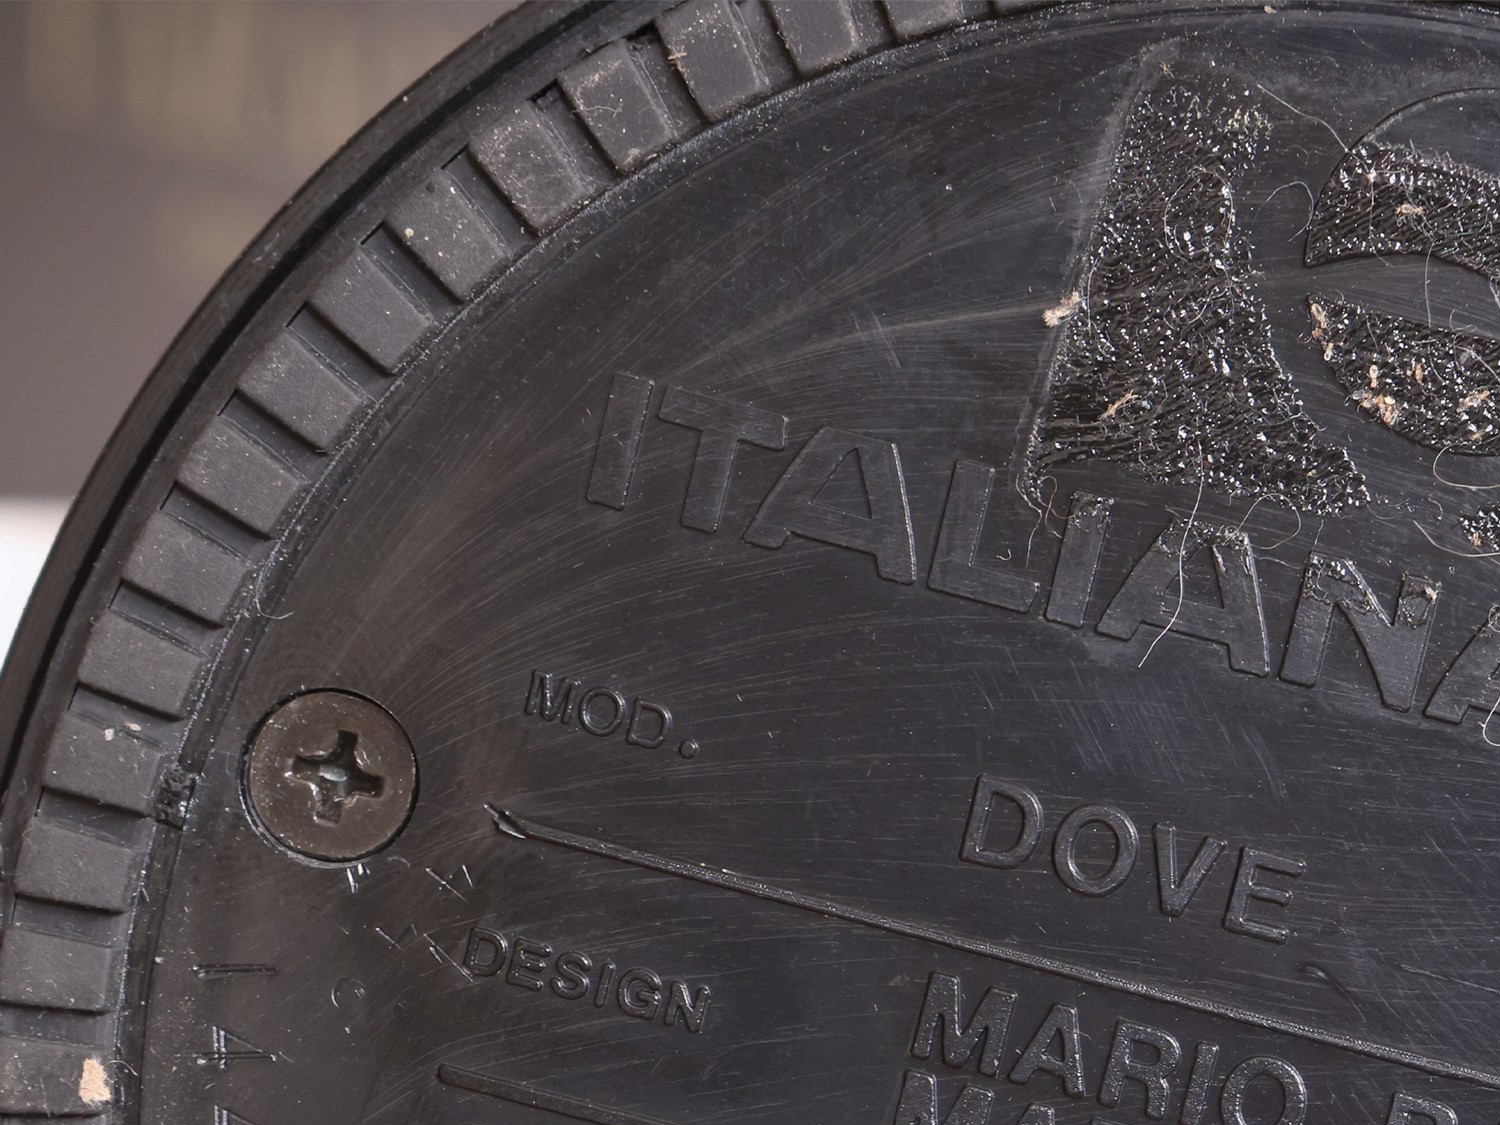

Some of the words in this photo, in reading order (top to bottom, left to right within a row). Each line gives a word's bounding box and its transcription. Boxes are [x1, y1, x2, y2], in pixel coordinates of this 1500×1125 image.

[524, 668, 700, 760] MOD.
[957, 772, 1309, 946] DOVE
[462, 926, 711, 1033] DESIGN
